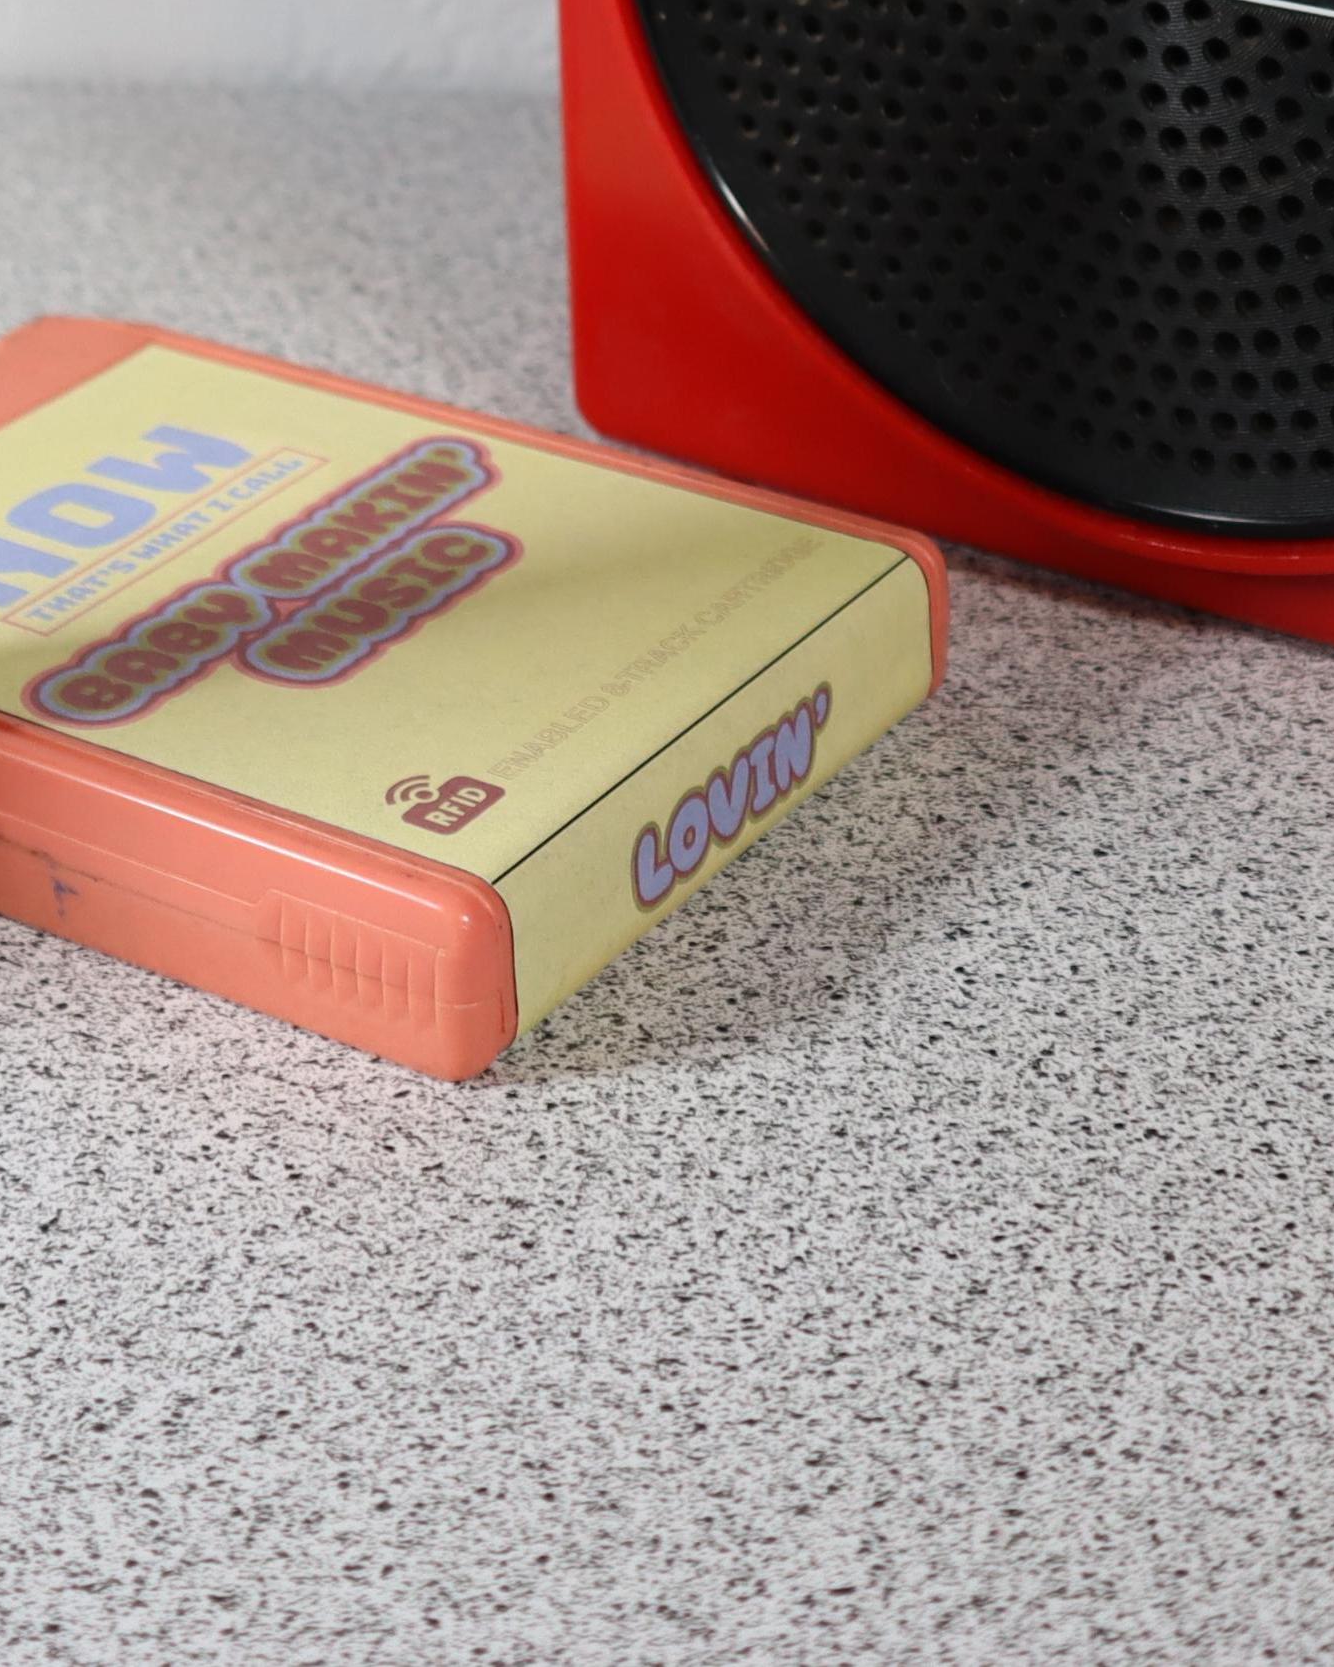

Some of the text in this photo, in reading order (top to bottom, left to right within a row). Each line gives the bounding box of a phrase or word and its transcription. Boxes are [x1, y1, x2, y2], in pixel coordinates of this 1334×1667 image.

[24, 553, 138, 623] THAT'S
[129, 510, 213, 561] WHAT
[230, 459, 305, 501] CALL
[50, 442, 480, 718] BABY MAKIN'
[255, 530, 501, 677] MUSIC
[423, 786, 488, 828] RFID
[487, 694, 612, 782] ENABLED
[633, 683, 832, 908] LOVIN'
